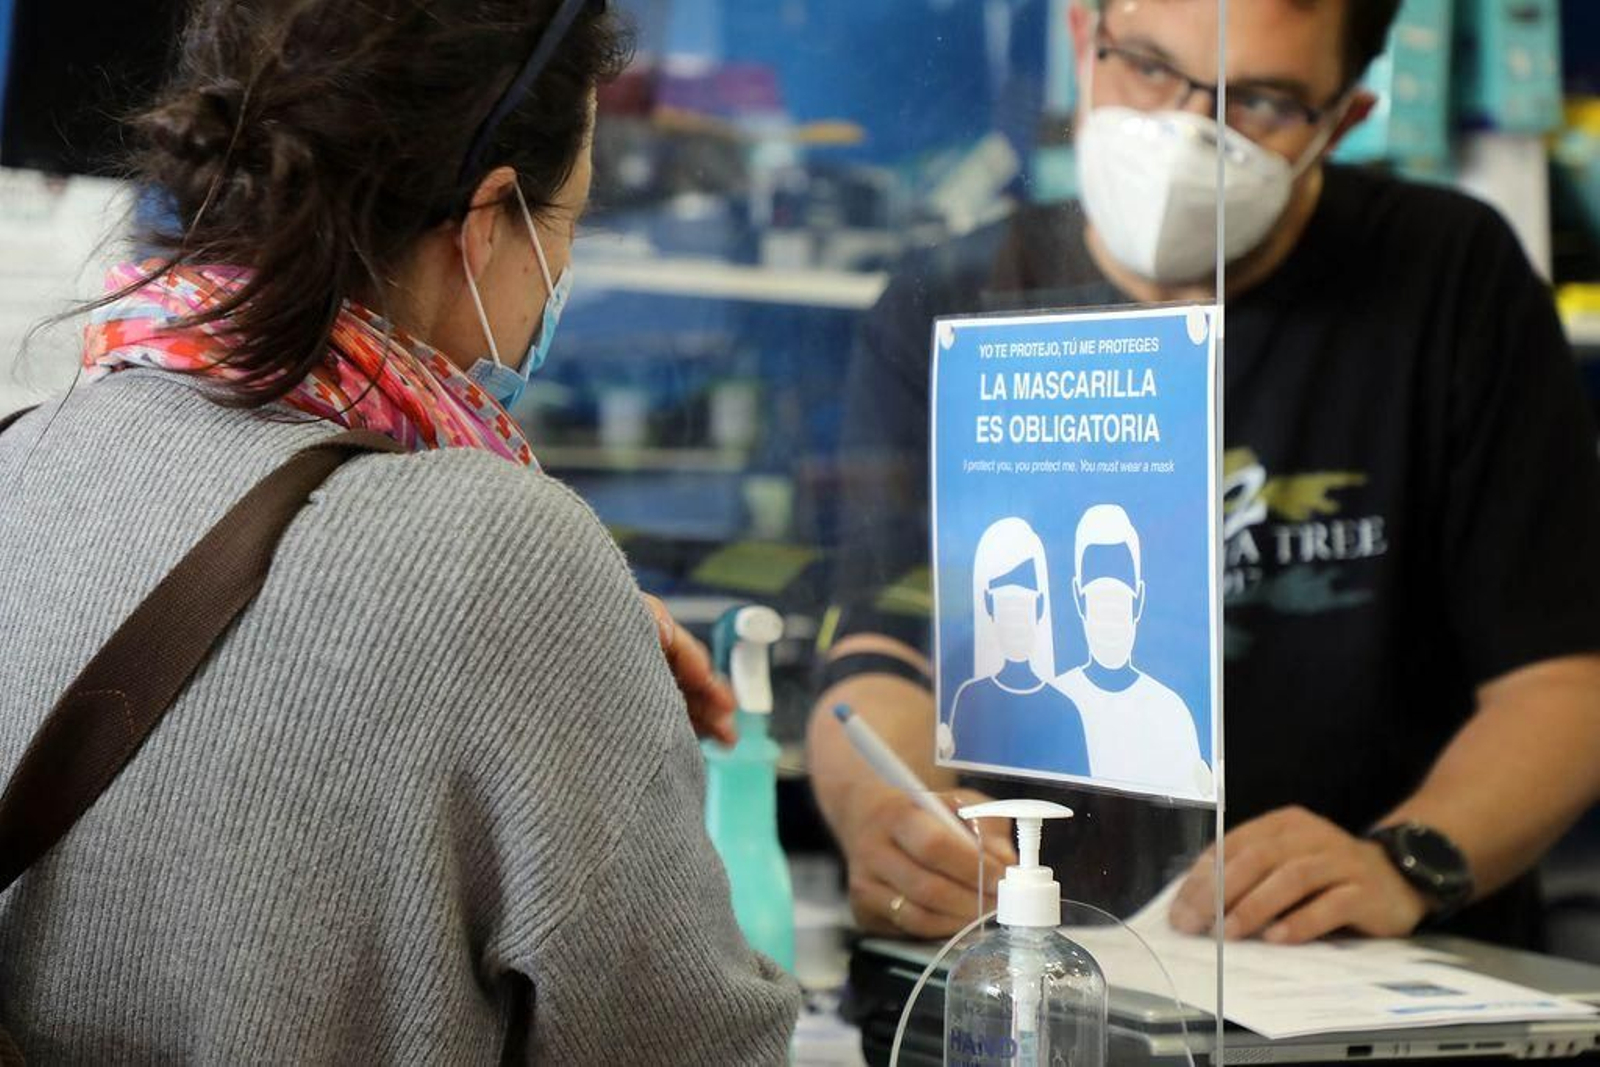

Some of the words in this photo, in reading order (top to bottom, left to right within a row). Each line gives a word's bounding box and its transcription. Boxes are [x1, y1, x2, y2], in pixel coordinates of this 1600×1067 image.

[979, 343, 993, 359] YO
[995, 343, 1008, 358] TE
[1010, 341, 1062, 358] PROTEJO,
[1062, 337, 1077, 355] TÚ
[1079, 339, 1096, 354] ME
[1099, 336, 1160, 354] PROTEGES
[979, 372, 1007, 400] LA
[1013, 368, 1157, 400] MASCARILLA
[976, 415, 1003, 443] ES
[1009, 413, 1161, 443] OBLIGATORIA
[968, 460, 995, 473] protect
[1014, 461, 1030, 474] you
[1031, 459, 1061, 474] protect
[1080, 459, 1096, 472] You
[1097, 459, 1119, 473] must
[1120, 461, 1142, 473] wear
[1142, 461, 1149, 473] a
[1150, 459, 1175, 473] mask
[1272, 514, 1388, 565] TREE
